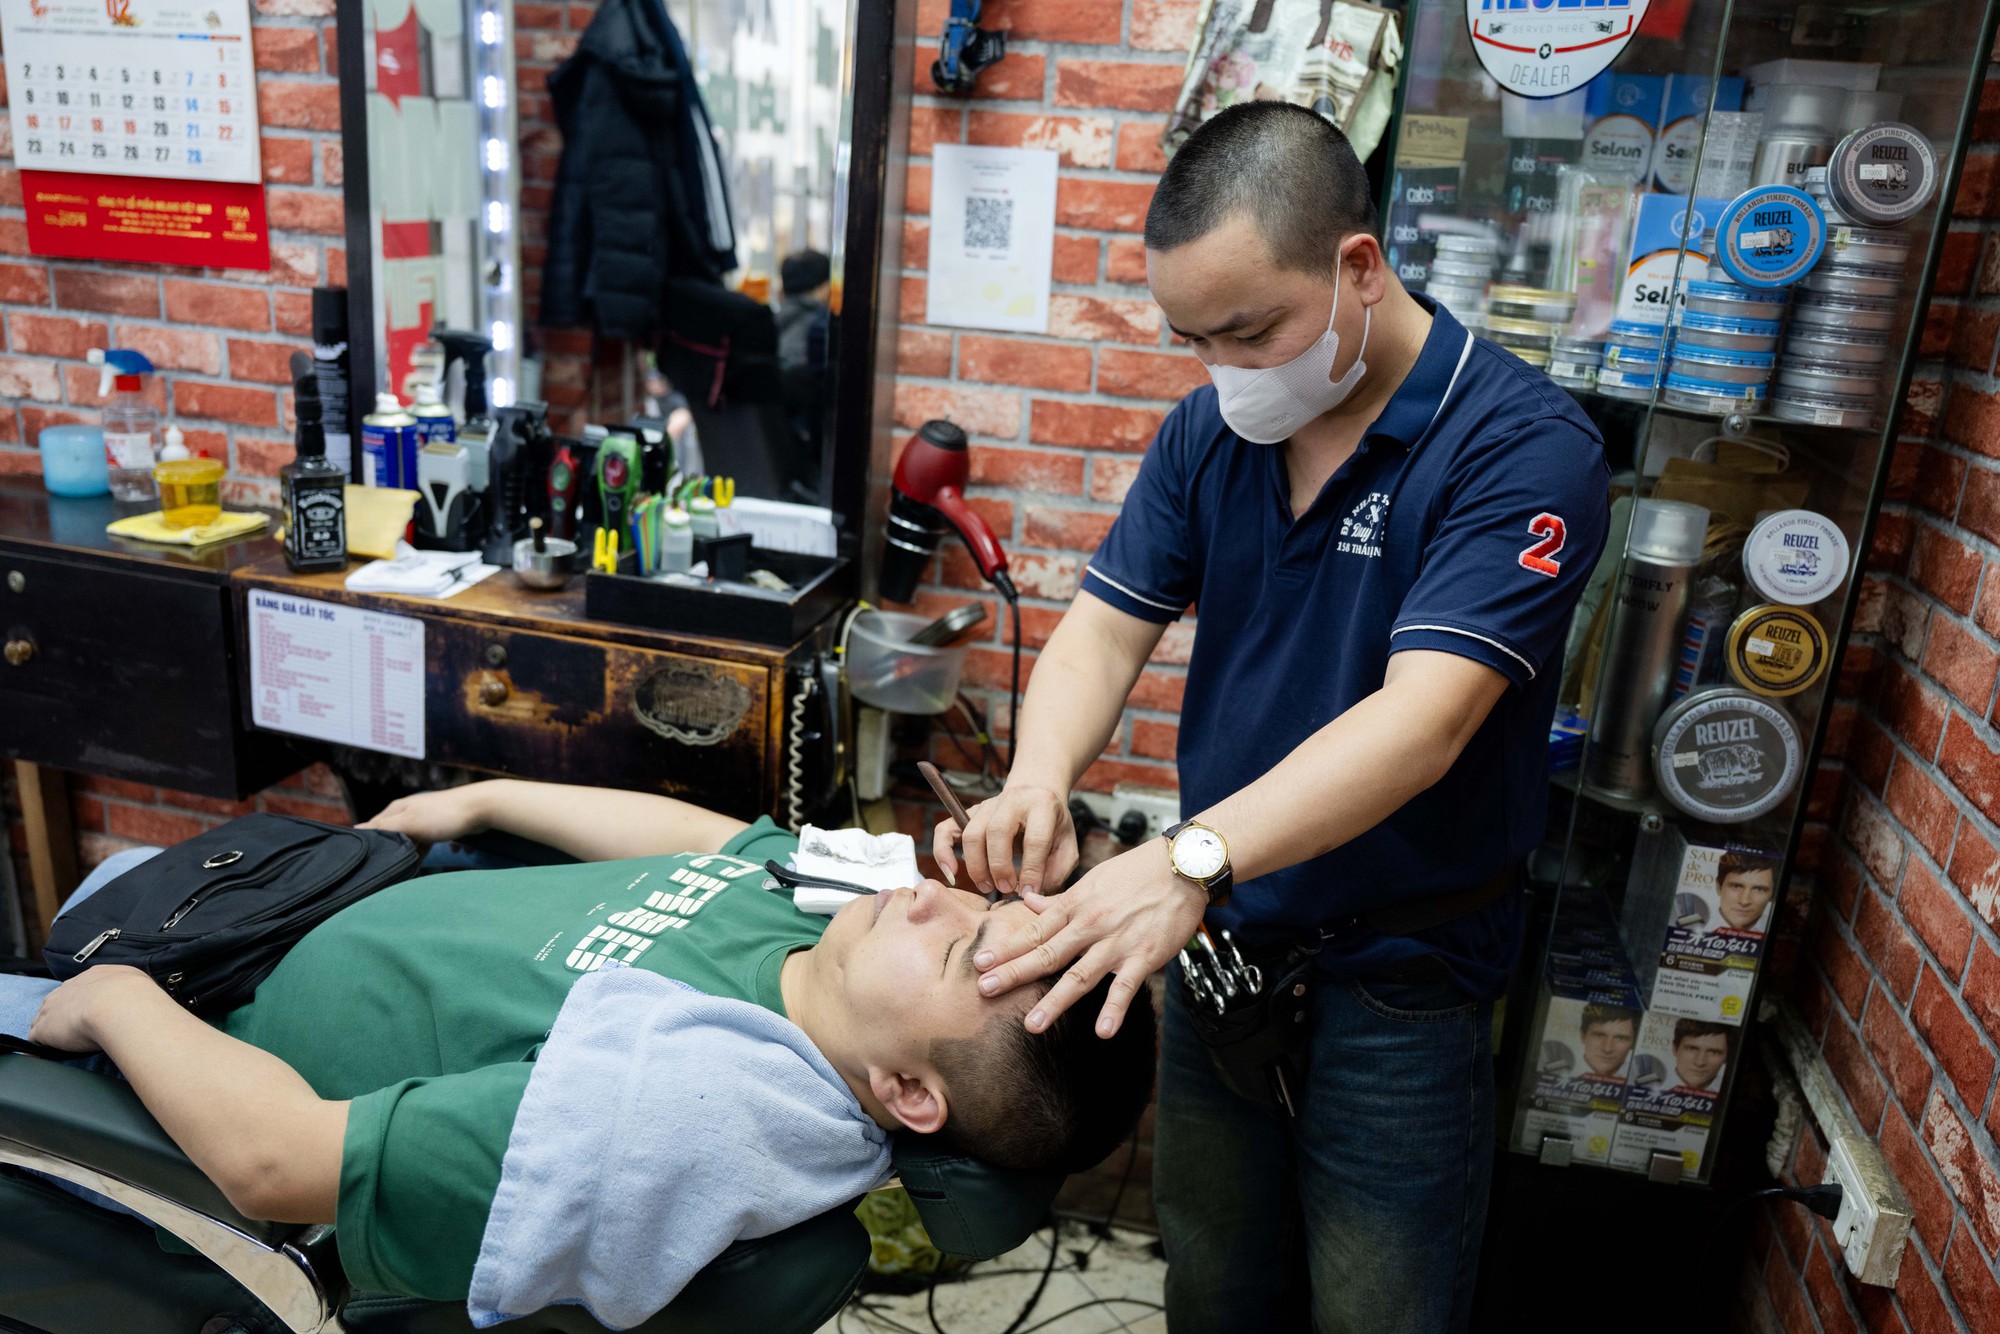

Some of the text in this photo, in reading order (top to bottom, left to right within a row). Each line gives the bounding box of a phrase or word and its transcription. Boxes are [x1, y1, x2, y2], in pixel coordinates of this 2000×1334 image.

[1512, 23, 1585, 34] SERVED HERE
[1509, 63, 1570, 87] DEALER
[1591, 140, 1642, 159] Selsun
[1853, 129, 1884, 153] HOLLANDS
[1884, 129, 1907, 138] FINEST
[1871, 144, 1909, 161] REUZEL
[1734, 194, 1815, 223] HOLLANDS FINEST POMADE
[1753, 210, 1794, 227] REUZEL
[1765, 518, 1840, 547] HOLLANDS FINEST POMADE
[1336, 541, 1351, 553] 158
[1518, 511, 1567, 578] 2
[1783, 533, 1820, 550] REUZEL
[1765, 624, 1802, 644] REUZEL
[1662, 699, 1795, 759] HOLLANDS FINEST POMADE
[1695, 717, 1760, 746] REUZEL
[1686, 860, 1701, 871] de
[1689, 848, 1742, 866] SALON
[1684, 871, 1714, 885] PRO
[1668, 929, 1758, 954] ニオイのない
[1665, 954, 1675, 965] 6
[1659, 979, 1674, 987] Save
[1674, 975, 1690, 983] what
[1642, 1035, 1670, 1047] PRO
[1628, 1089, 1713, 1111] ニオイのない
[1625, 1111, 1634, 1122] 6
